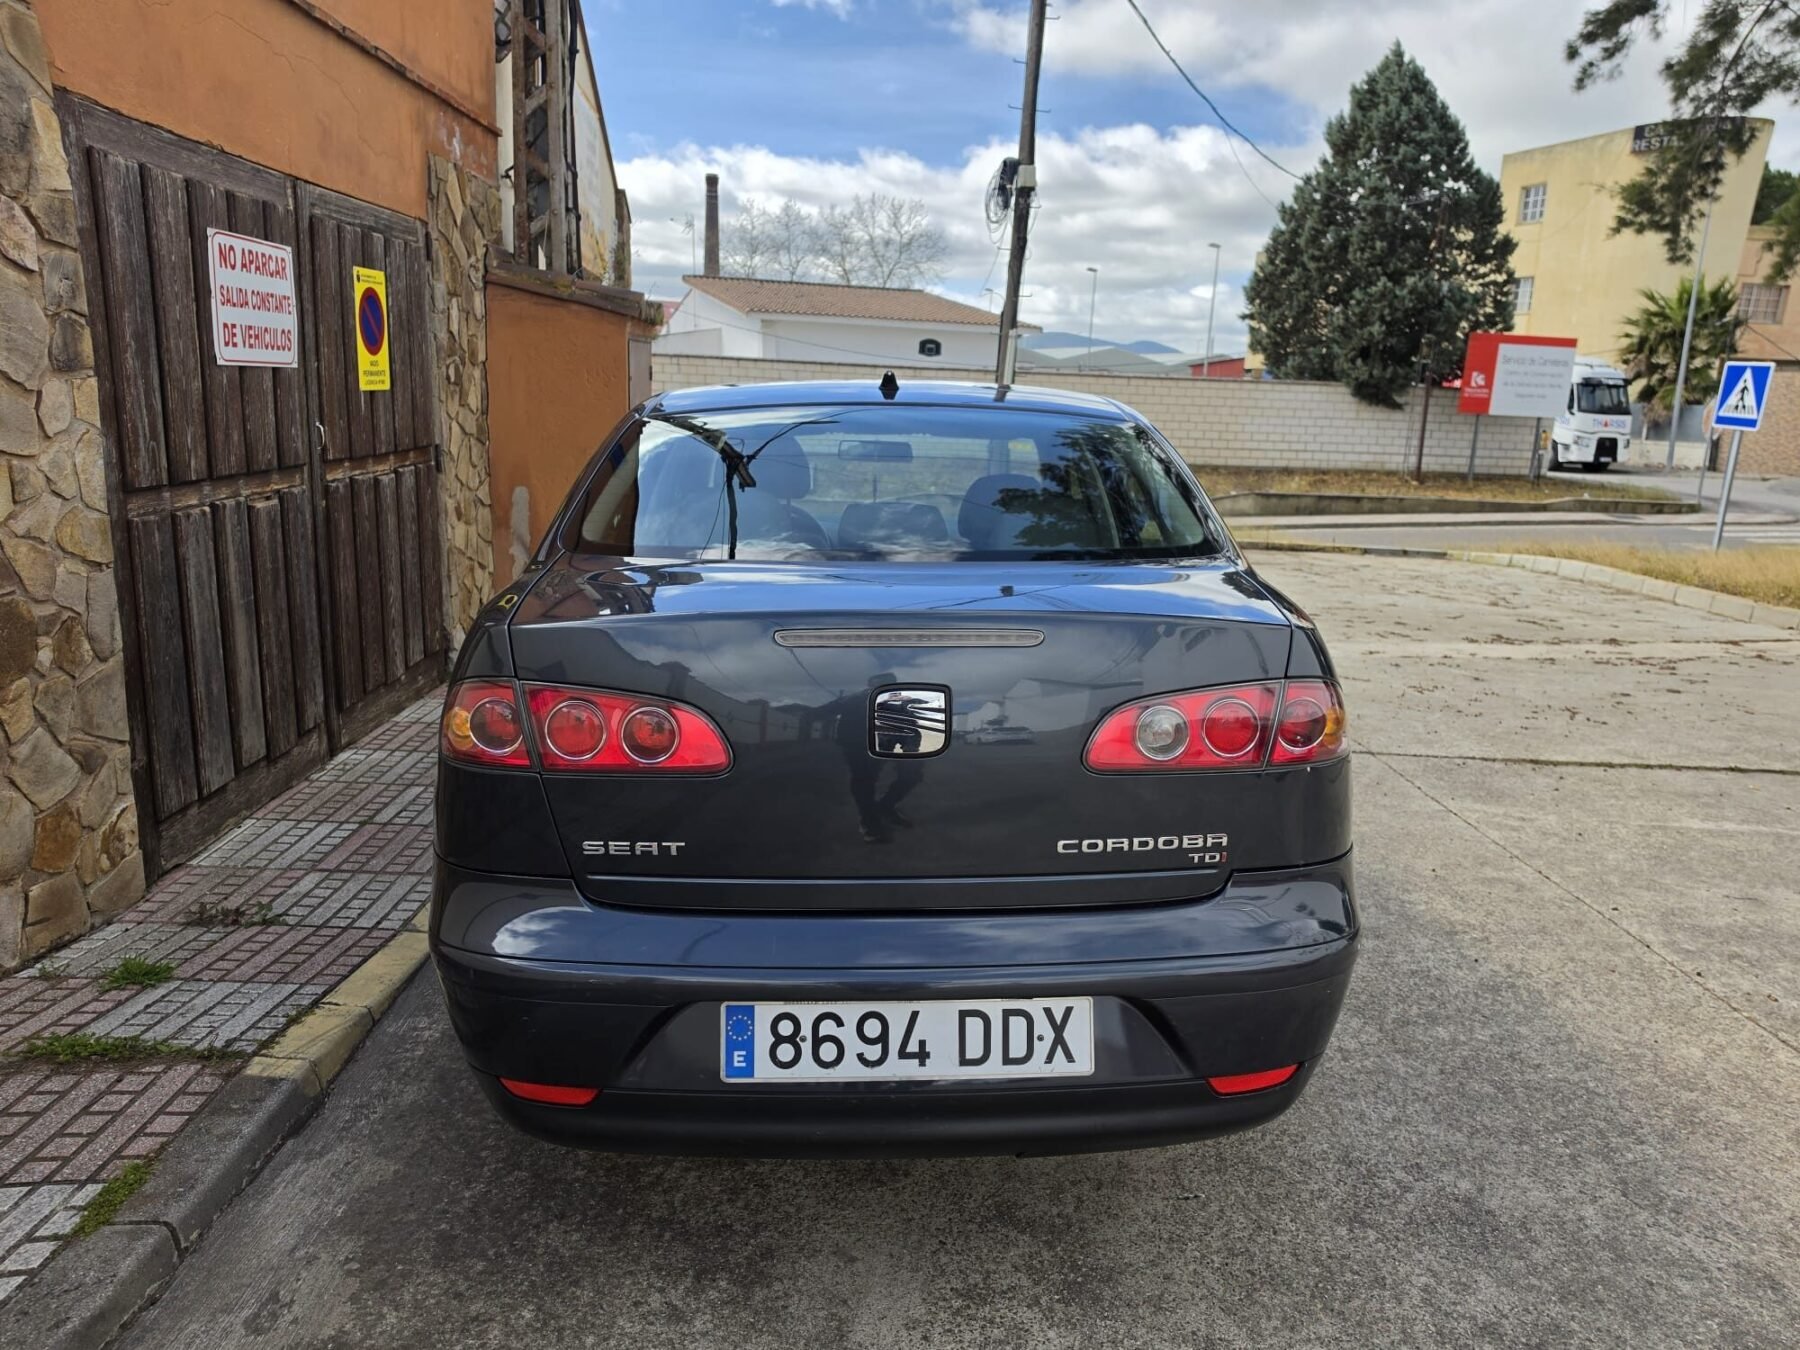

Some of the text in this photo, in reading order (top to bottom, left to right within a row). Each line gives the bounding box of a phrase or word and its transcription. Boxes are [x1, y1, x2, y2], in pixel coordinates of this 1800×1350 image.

[218, 242, 288, 281] NO APARCAR
[220, 284, 292, 315] SALIDA CONSTANTE
[223, 322, 292, 352] DE VEHICULOS
[582, 841, 685, 855] SEAT
[1057, 833, 1228, 853] CORDOBA
[769, 1006, 1076, 1069] 8694 DDX
[733, 1051, 746, 1067] E
